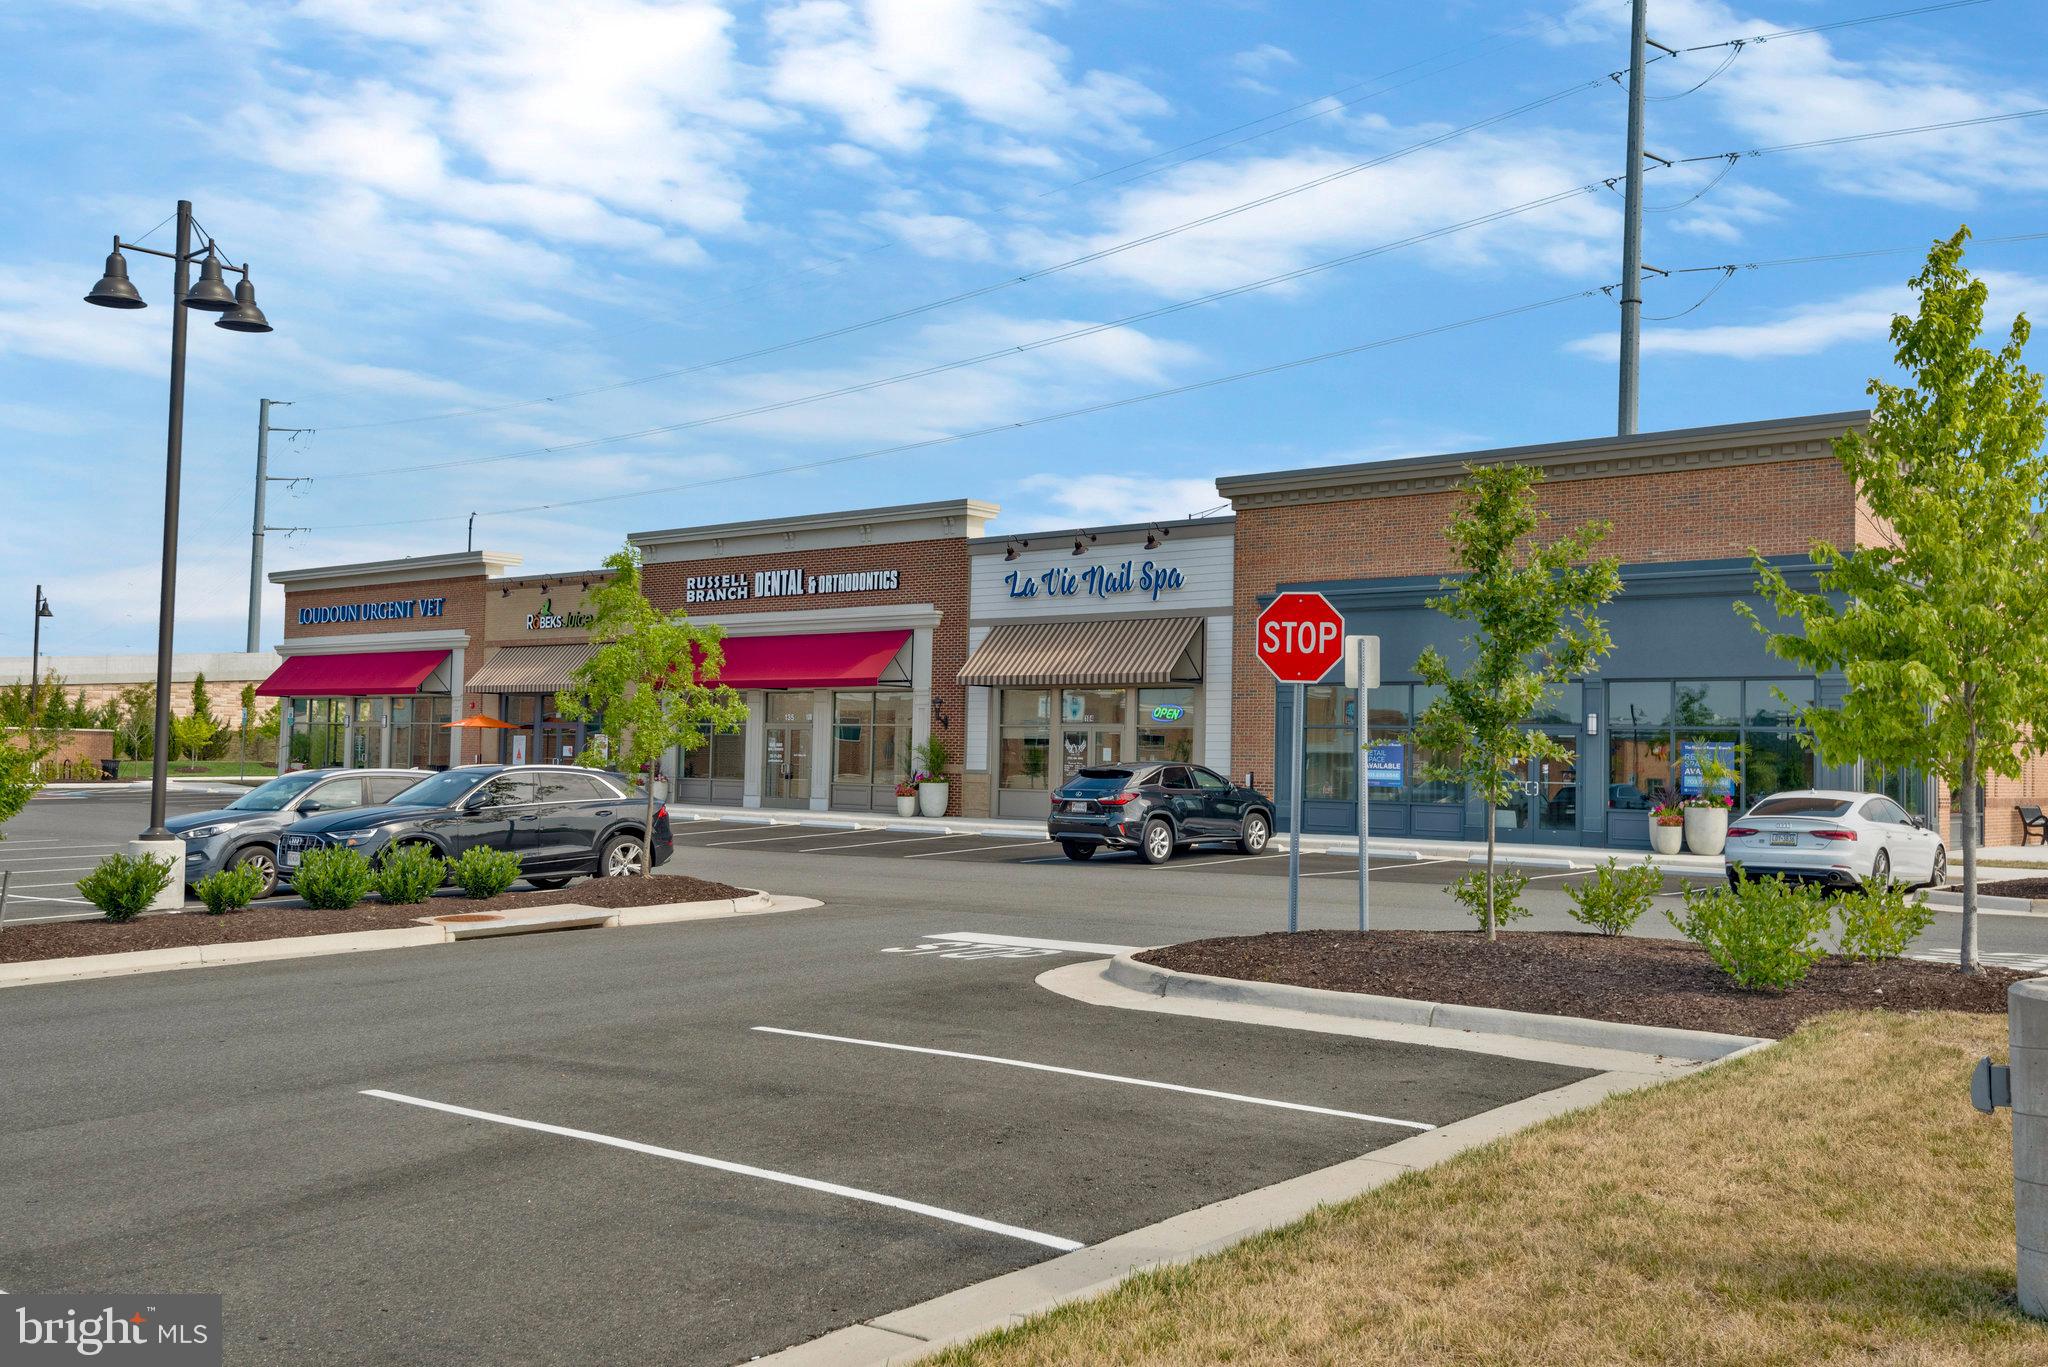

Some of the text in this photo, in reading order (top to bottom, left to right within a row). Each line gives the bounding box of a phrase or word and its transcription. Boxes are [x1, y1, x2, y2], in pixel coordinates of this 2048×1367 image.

[686, 574, 749, 590] RUSSELL
[755, 569, 899, 598] DENTAL & ORTHODONTICS
[1004, 560, 1187, 601] La Vie Nail Spa
[686, 587, 749, 602] BRANCH
[298, 597, 446, 625] LOUDOUN URGENT VET
[564, 611, 594, 628] Juice
[1262, 620, 1338, 654] STOP
[1153, 706, 1181, 720] OPEN
[1368, 749, 1387, 757] ETAIL
